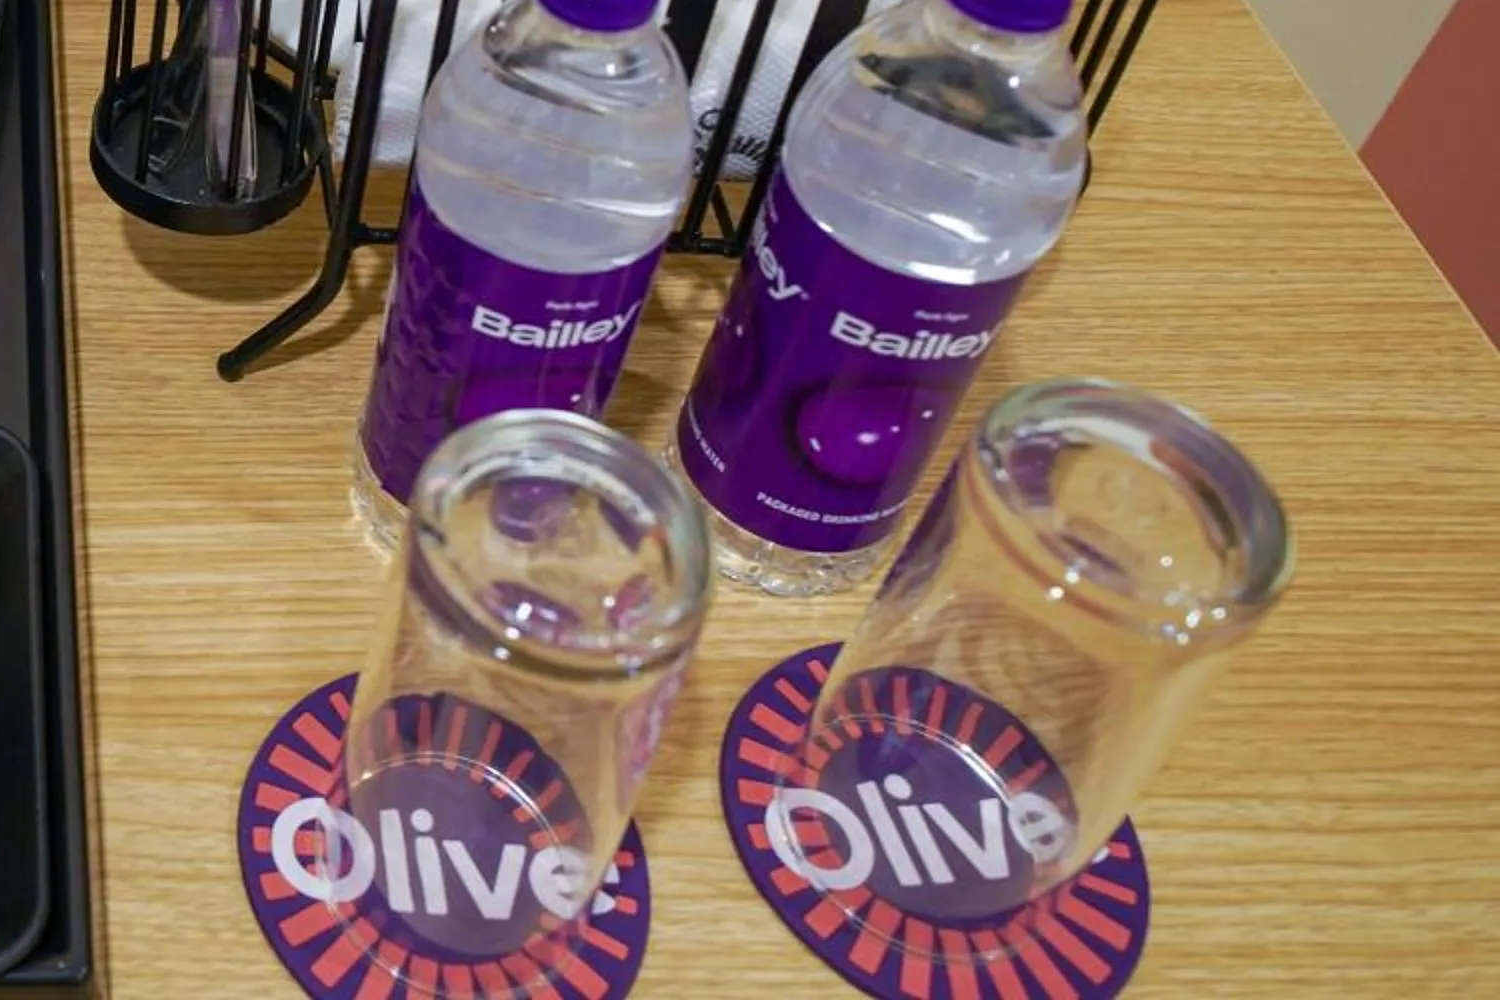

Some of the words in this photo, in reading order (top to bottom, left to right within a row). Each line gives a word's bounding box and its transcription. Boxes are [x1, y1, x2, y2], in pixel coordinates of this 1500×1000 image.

[471, 300, 642, 348] Bailley
[829, 311, 1003, 360] Bailley
[271, 797, 617, 919] Olive
[765, 773, 1080, 889] Olive
